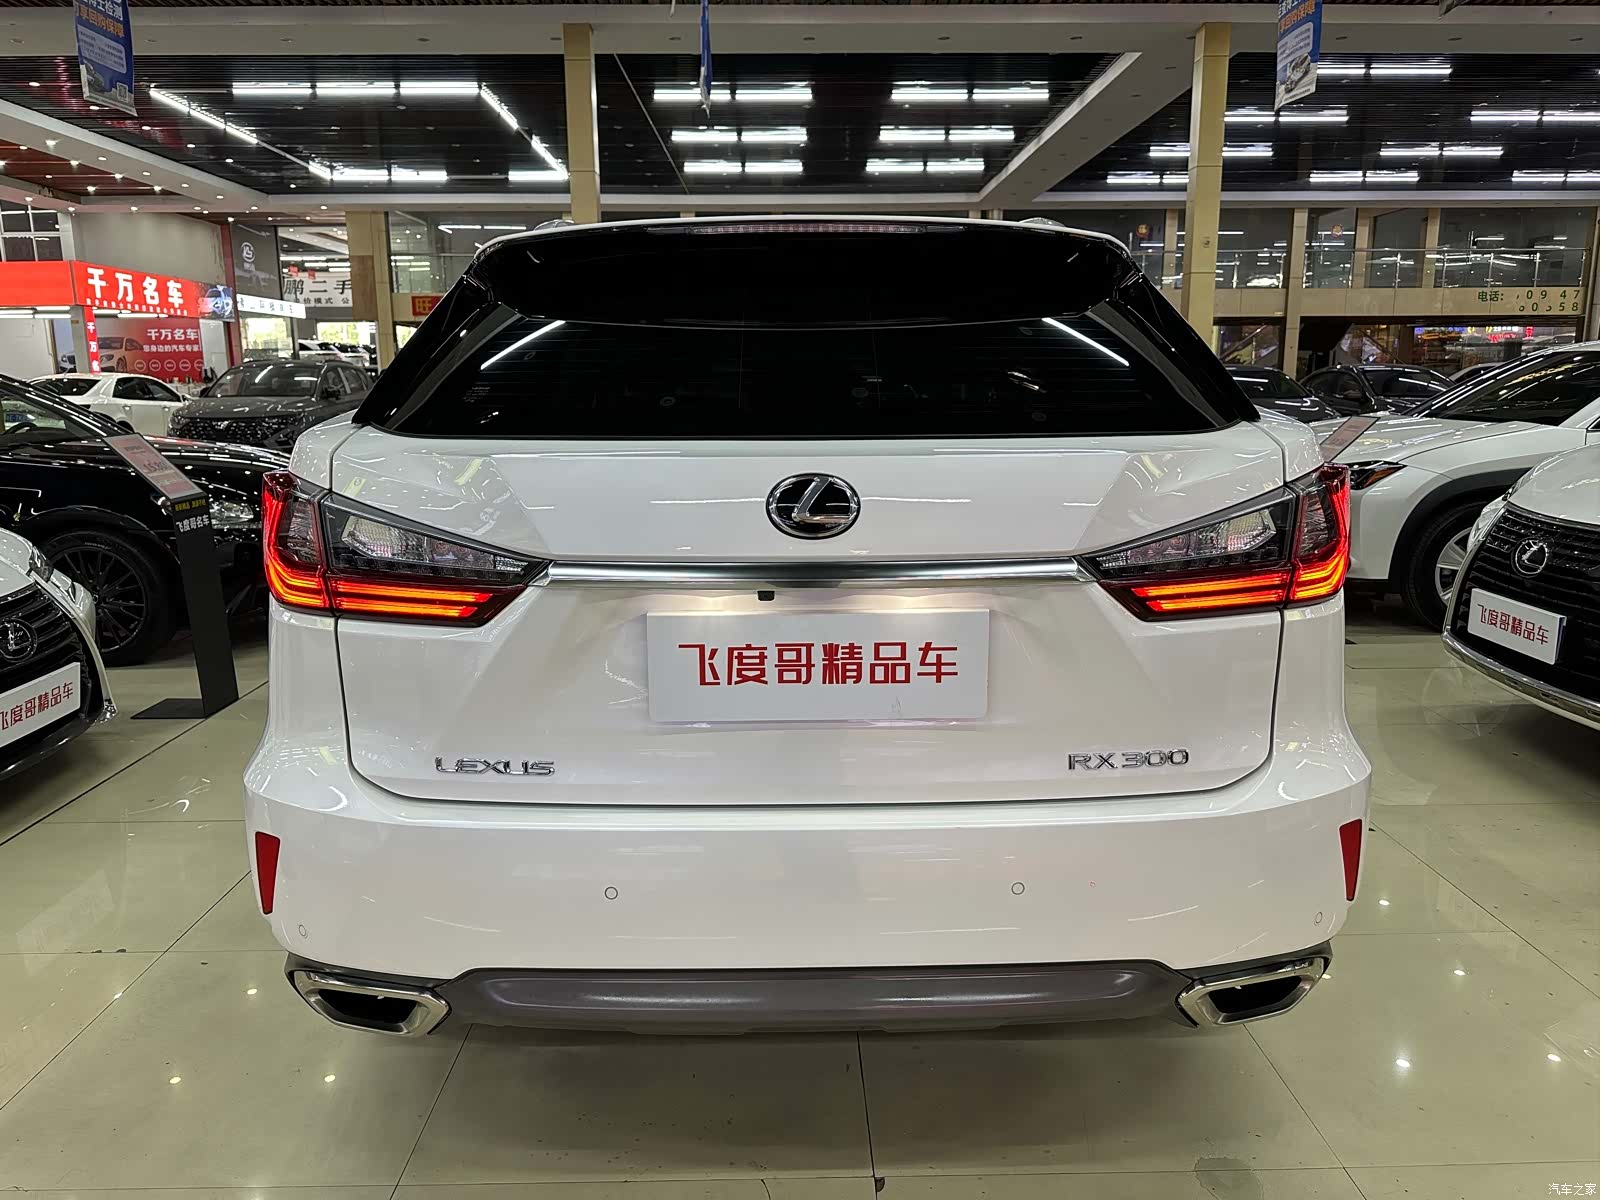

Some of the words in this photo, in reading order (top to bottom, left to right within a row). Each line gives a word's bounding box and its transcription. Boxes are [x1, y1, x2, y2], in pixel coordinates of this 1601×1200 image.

[87, 267, 183, 308] 千万名车
[147, 329, 198, 340] 千万名车
[175, 514, 210, 532] 飞度哥名车
[1477, 603, 1549, 645] 飞度哥精品车
[678, 641, 958, 686] 飞度哥精品车
[435, 757, 555, 776] LEXUS
[1068, 752, 1118, 770] RX
[1121, 748, 1189, 768] 300
